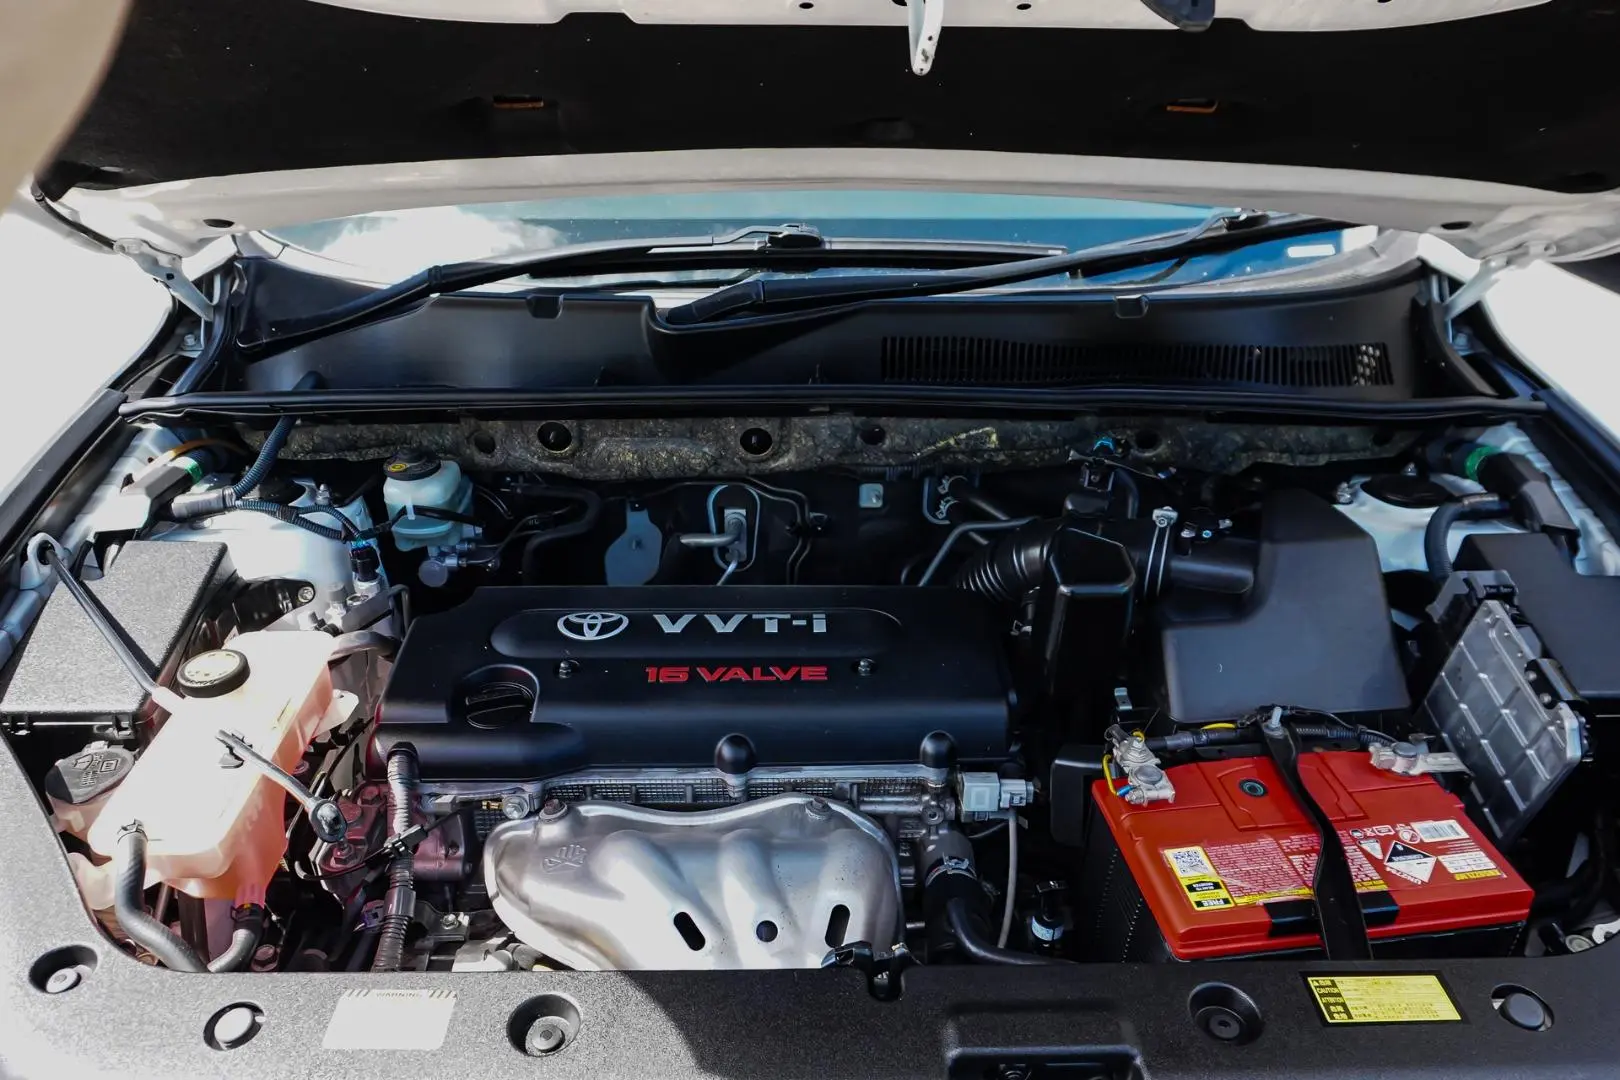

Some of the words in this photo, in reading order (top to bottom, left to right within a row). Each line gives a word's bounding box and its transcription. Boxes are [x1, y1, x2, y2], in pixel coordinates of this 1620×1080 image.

[653, 613, 827, 633] VVT-i
[646, 666, 690, 683] 16
[696, 666, 828, 683] VALVE
[1201, 898, 1224, 907] FREE
